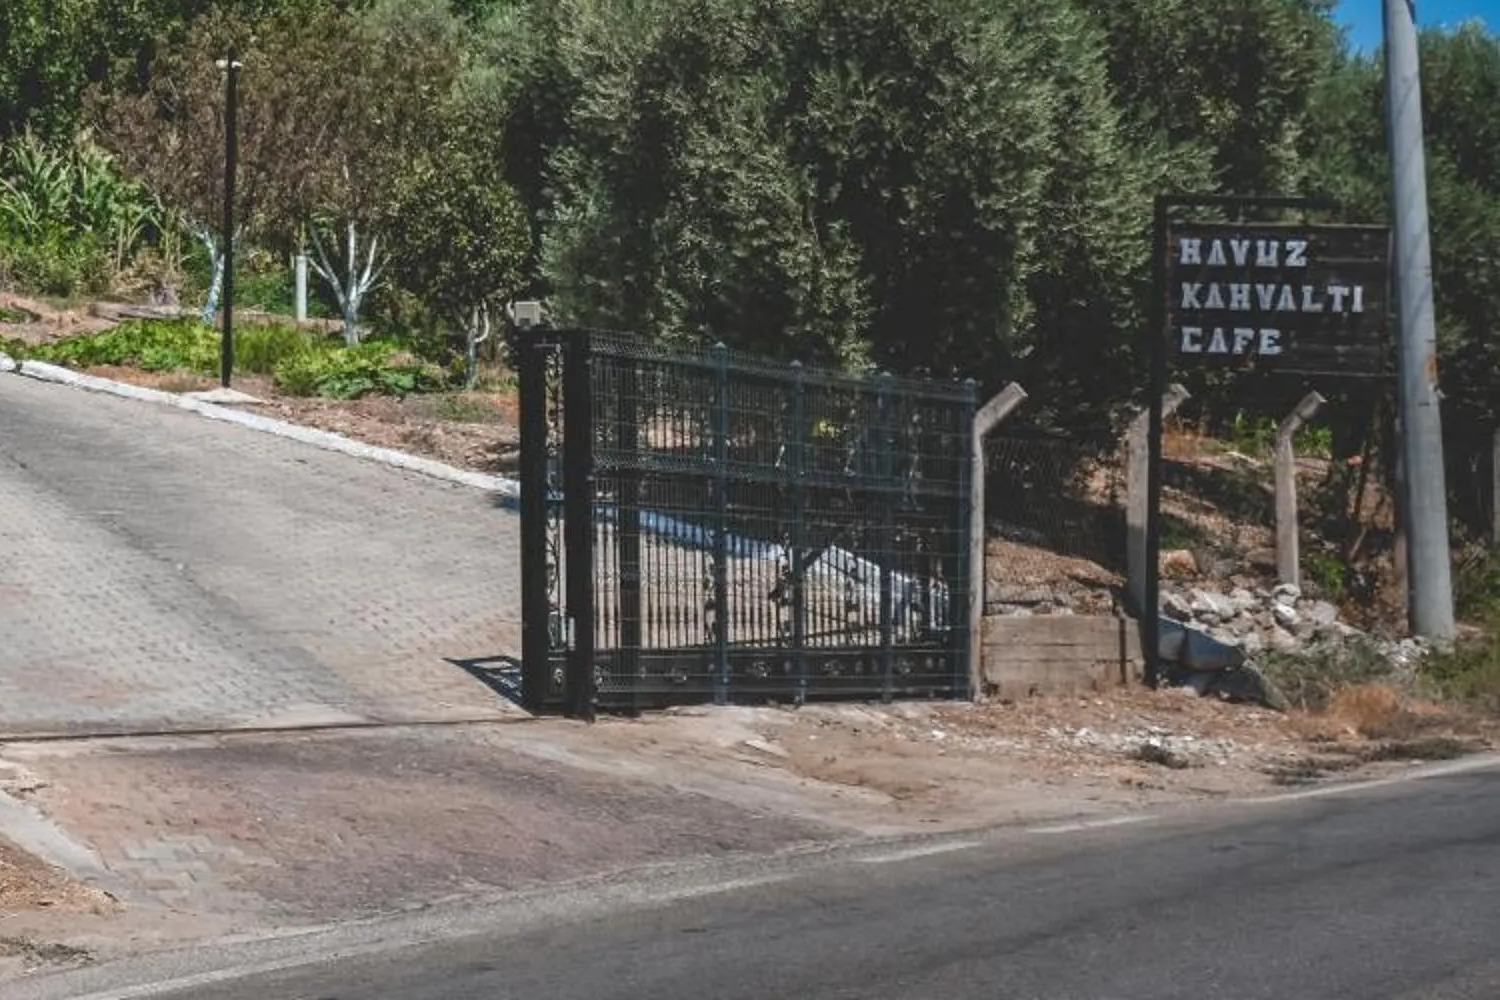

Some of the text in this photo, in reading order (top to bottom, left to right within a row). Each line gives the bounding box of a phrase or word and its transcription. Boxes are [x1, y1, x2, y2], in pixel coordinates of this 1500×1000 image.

[1179, 238, 1308, 267] HAVUZ
[1181, 282, 1364, 312] KAHVALTI
[1181, 327, 1283, 355] CAFE
